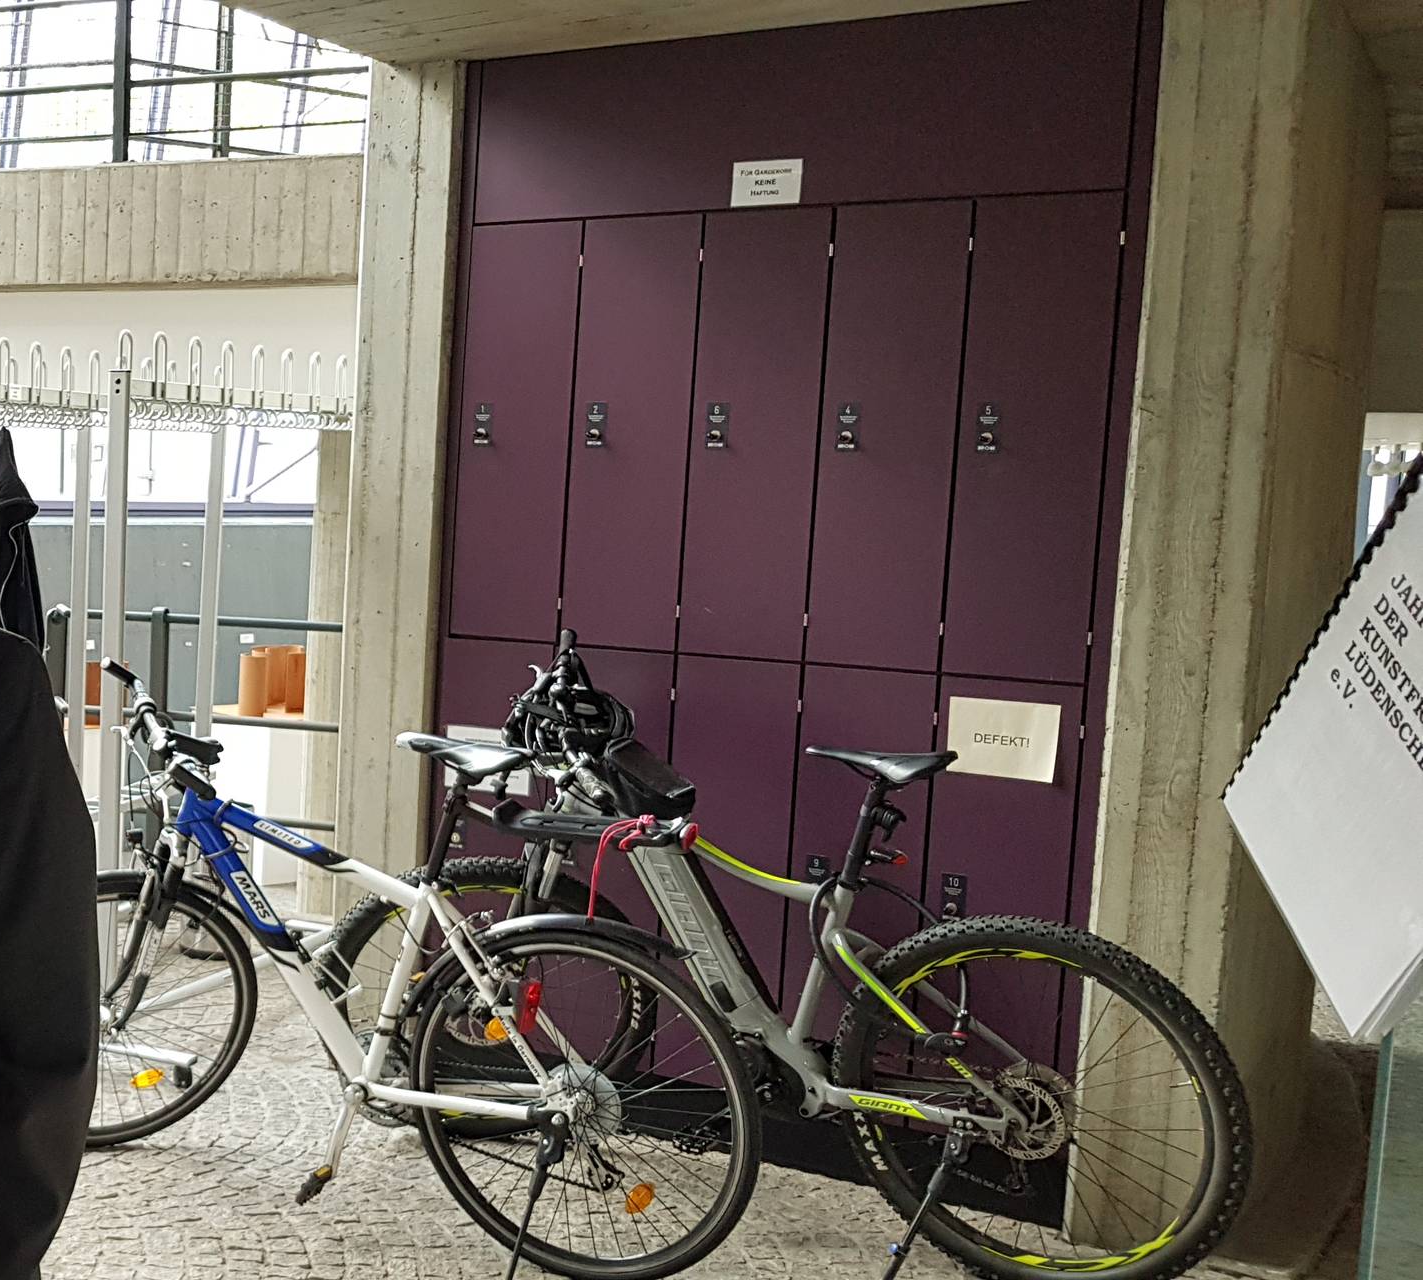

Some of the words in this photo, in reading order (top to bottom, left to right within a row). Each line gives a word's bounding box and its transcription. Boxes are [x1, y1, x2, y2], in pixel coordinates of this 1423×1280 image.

[754, 178, 777, 186] KEINE
[750, 189, 780, 197] HAFTUNG
[1374, 593, 1409, 647] DER
[973, 732, 1030, 748] DEFEKT!
[259, 822, 302, 846] LIMITED
[949, 877, 959, 887] 10
[234, 875, 271, 920] MARS
[517, 1044, 542, 1079] Germany
[857, 1098, 914, 1114] GIANT
